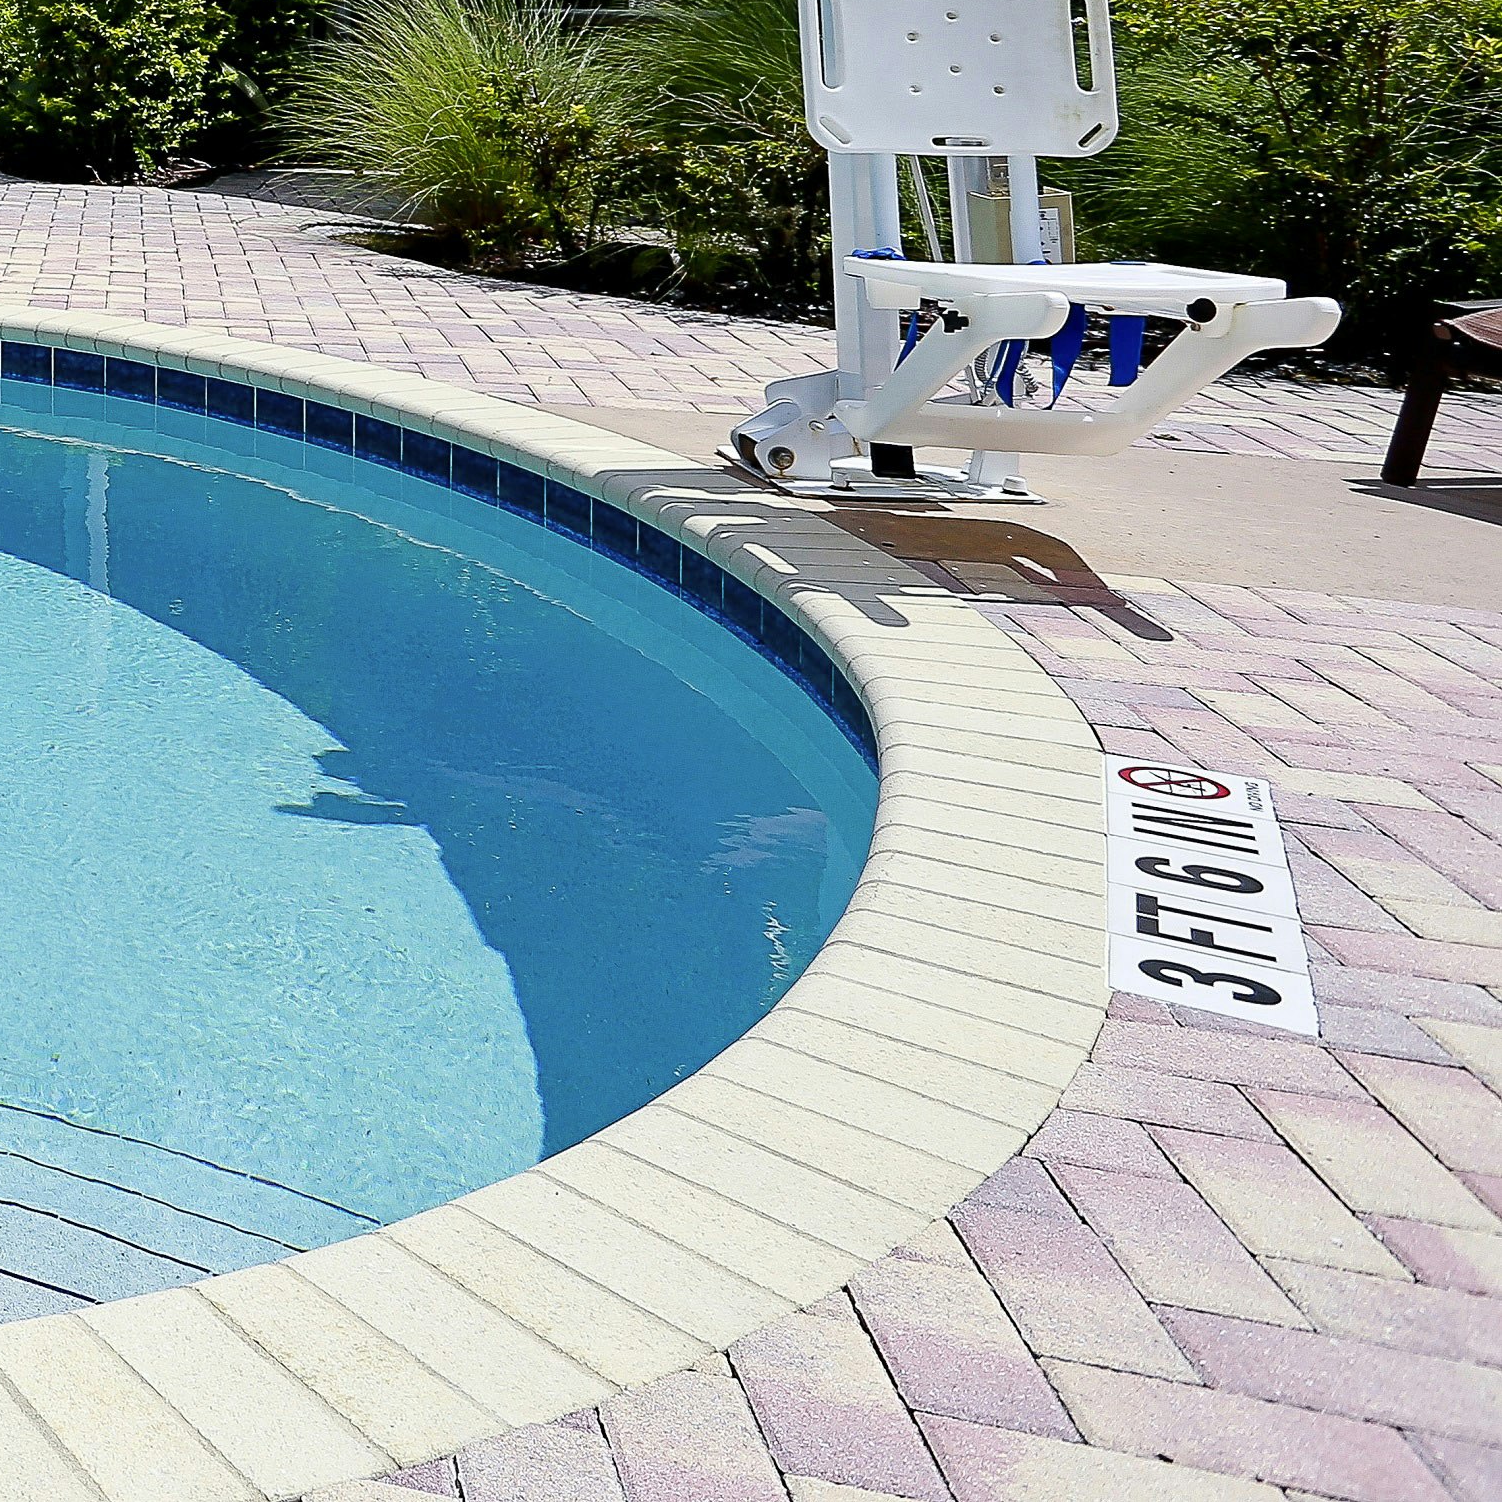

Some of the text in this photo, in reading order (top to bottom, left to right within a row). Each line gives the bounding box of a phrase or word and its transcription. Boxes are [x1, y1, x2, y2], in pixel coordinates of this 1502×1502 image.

[1131, 801, 1282, 1006] 3 FT 6 IN
